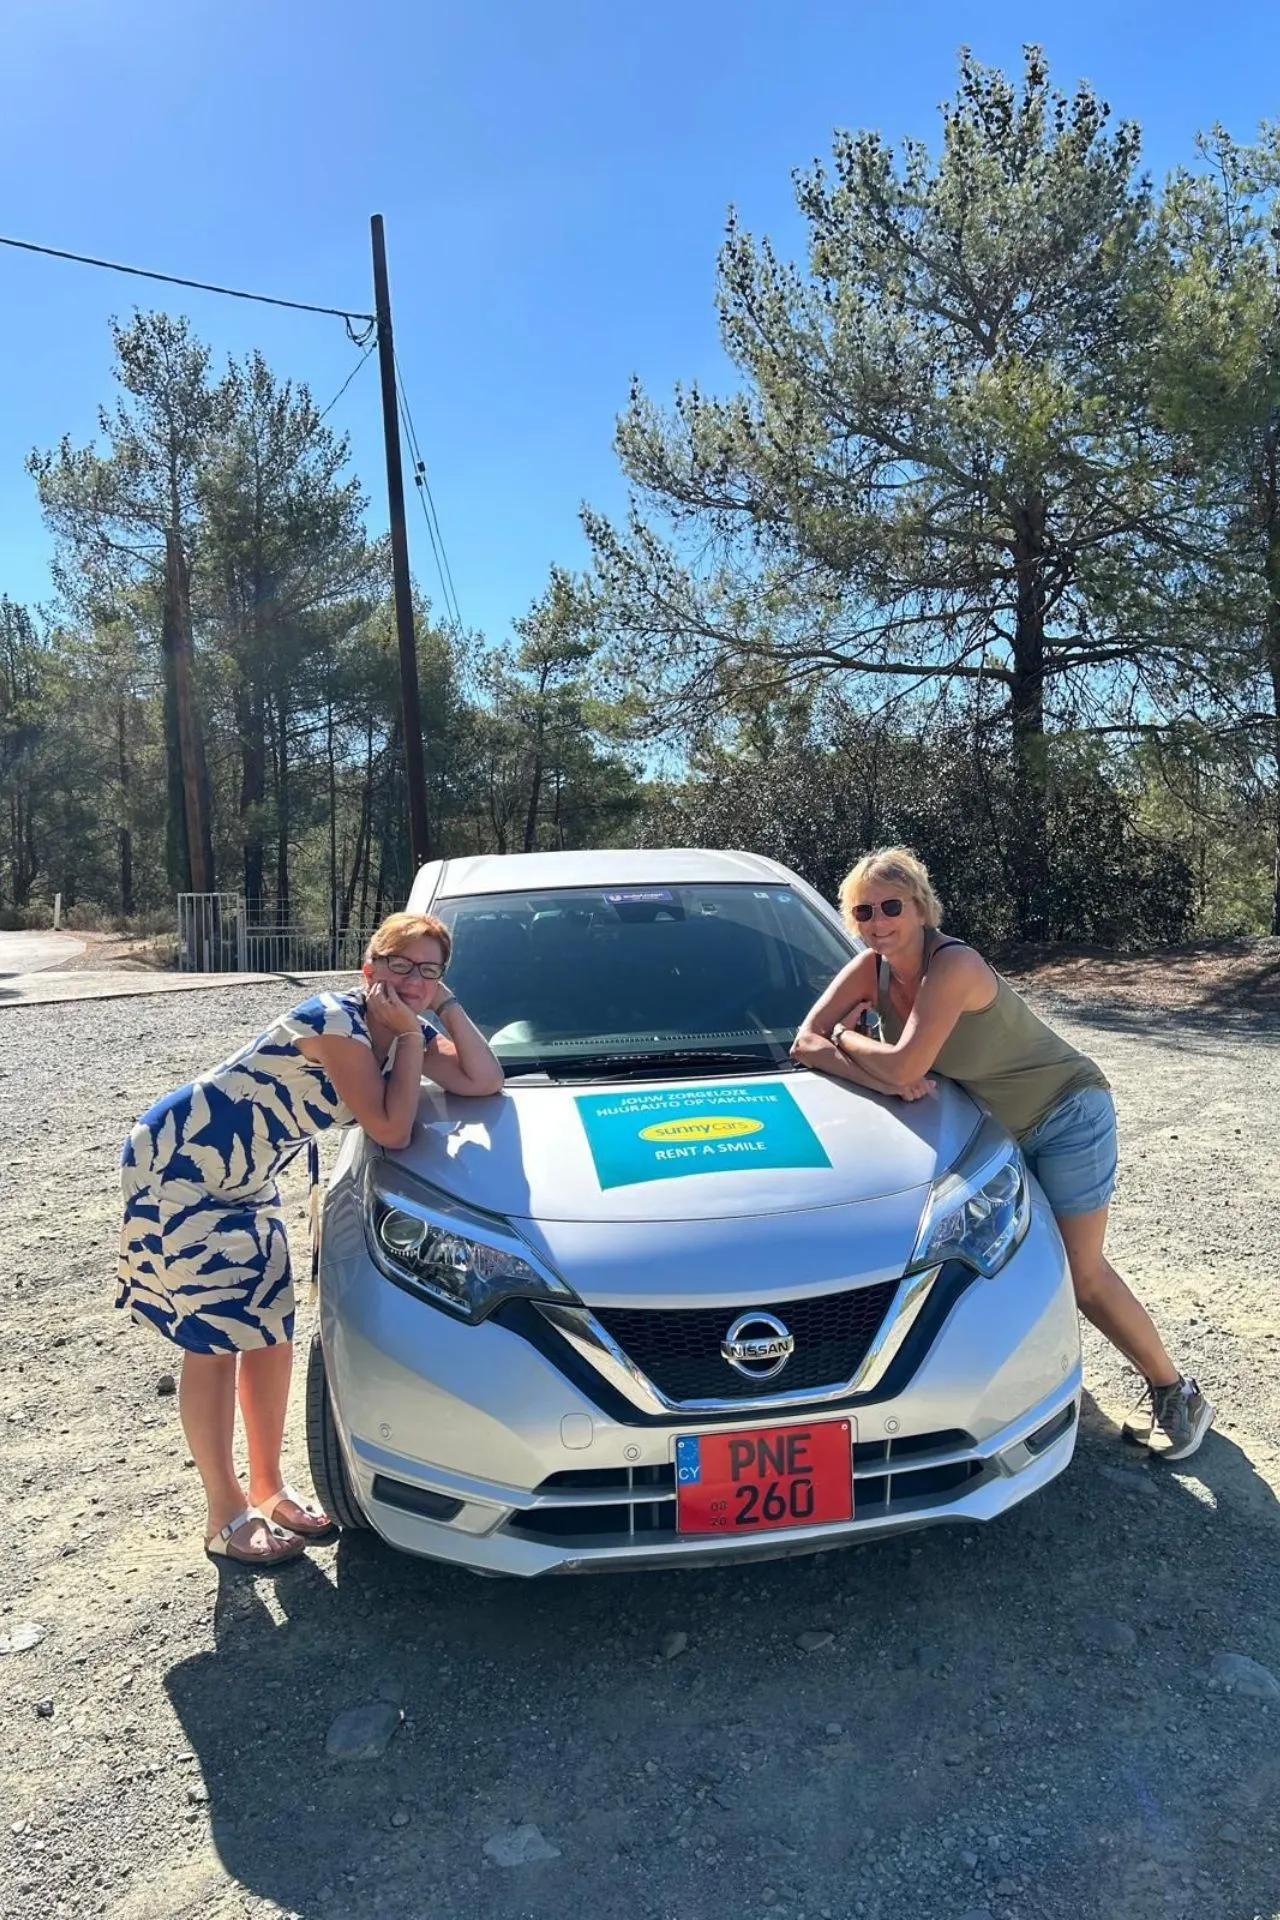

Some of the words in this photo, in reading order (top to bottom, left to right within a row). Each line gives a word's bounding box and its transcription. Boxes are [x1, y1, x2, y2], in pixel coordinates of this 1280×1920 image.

[596, 1101, 680, 1116] HUURAUTO
[707, 1095, 778, 1105] VAKANTIE
[620, 1095, 664, 1106] JOUW
[668, 1089, 748, 1100] ZORGELOZE
[655, 1146, 697, 1160] RENT
[703, 1145, 716, 1155] A
[717, 1141, 767, 1153] SMILE
[730, 1341, 788, 1357] NISSAN
[728, 1433, 813, 1481] PNE
[679, 1466, 700, 1480] CY
[735, 1479, 814, 1525] 260
